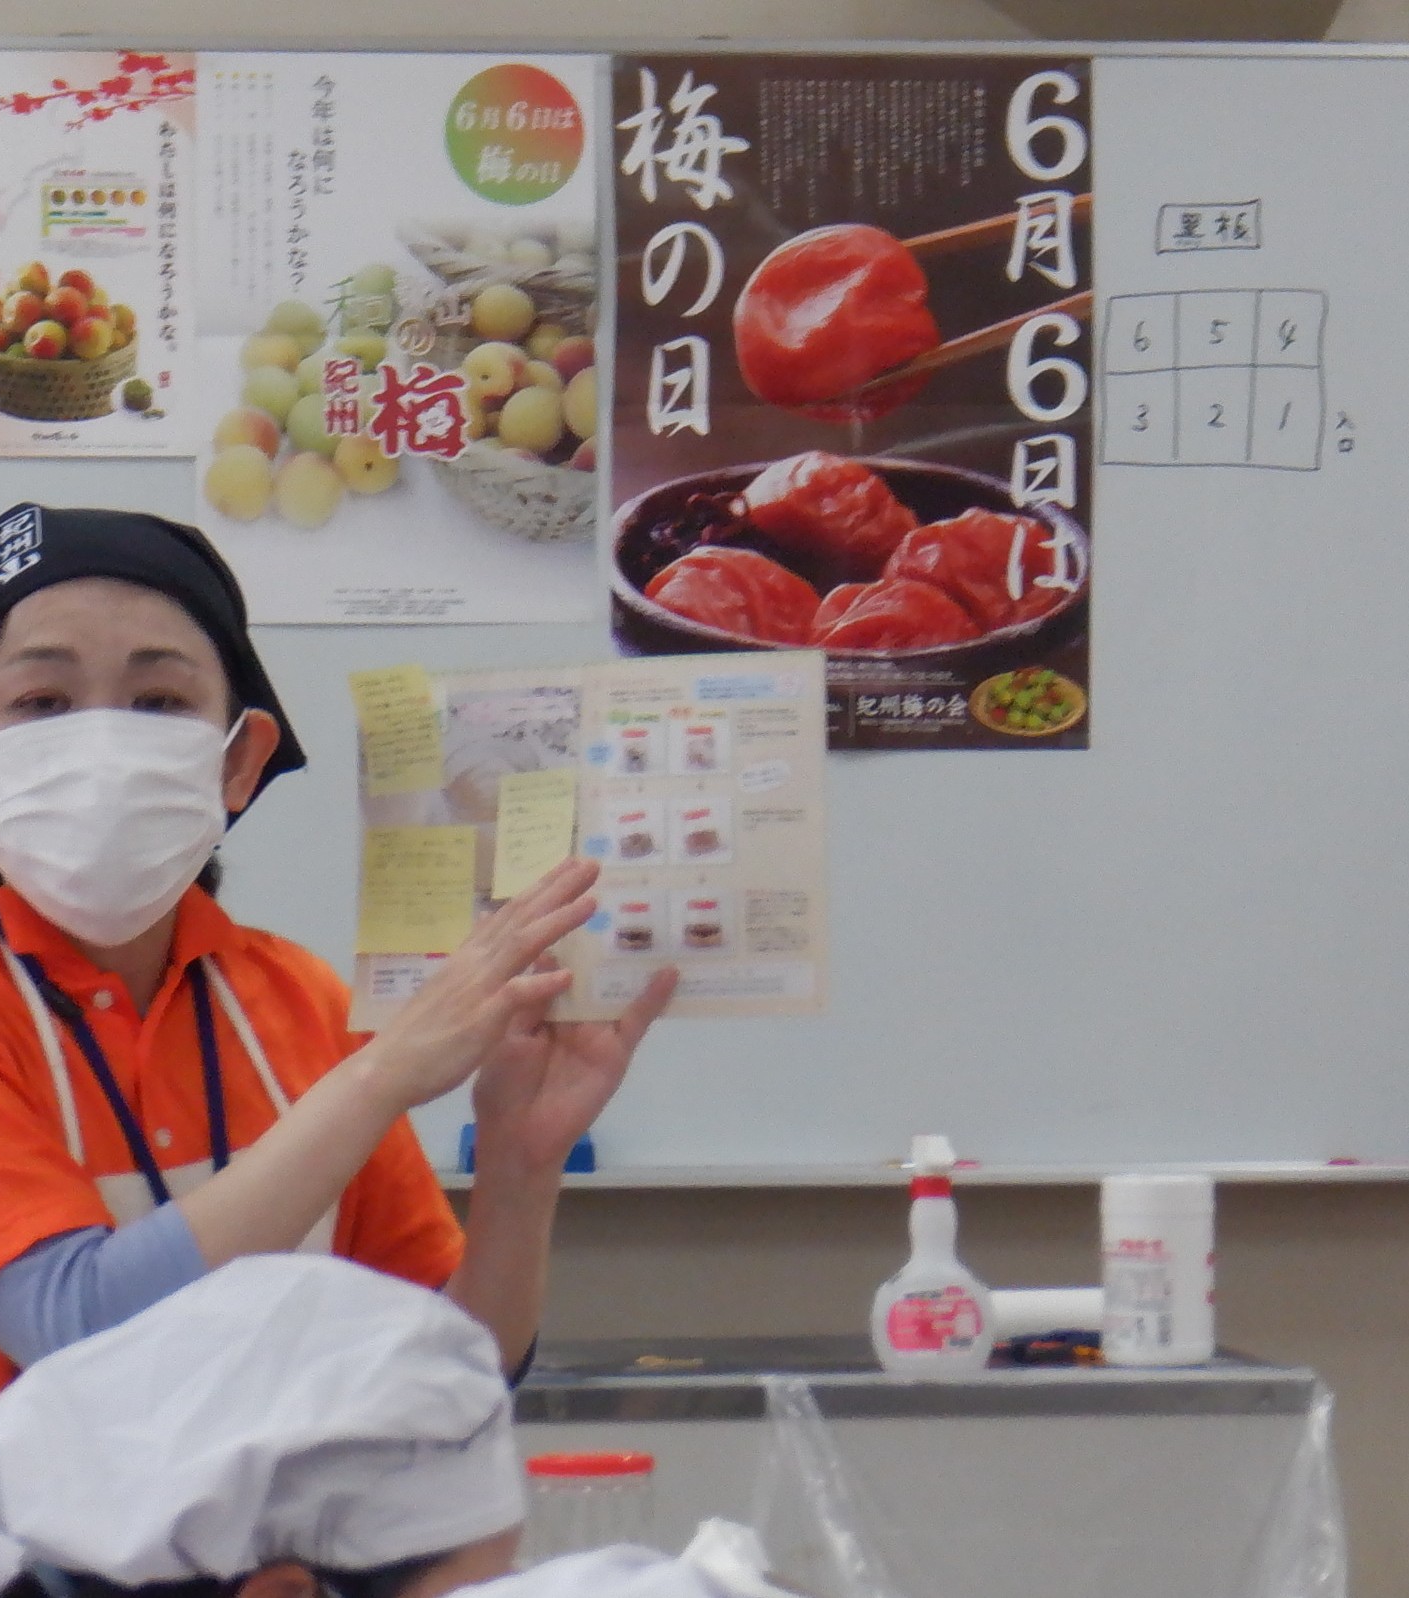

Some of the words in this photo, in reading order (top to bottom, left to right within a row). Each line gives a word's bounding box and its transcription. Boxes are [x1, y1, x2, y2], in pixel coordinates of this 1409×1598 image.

[312, 73, 336, 196] 今年は何に
[455, 99, 577, 131] 6月6日は
[476, 143, 561, 185] 梅の日
[616, 66, 751, 438] 梅の日
[1005, 69, 1088, 601] 6月6日は
[1133, 320, 1153, 352] 6
[1209, 319, 1231, 345] 5
[323, 358, 360, 436] 紀州
[372, 364, 468, 458] 梅
[1131, 403, 1150, 432] 3
[1207, 403, 1227, 429] 2
[1278, 402, 1292, 431] 1
